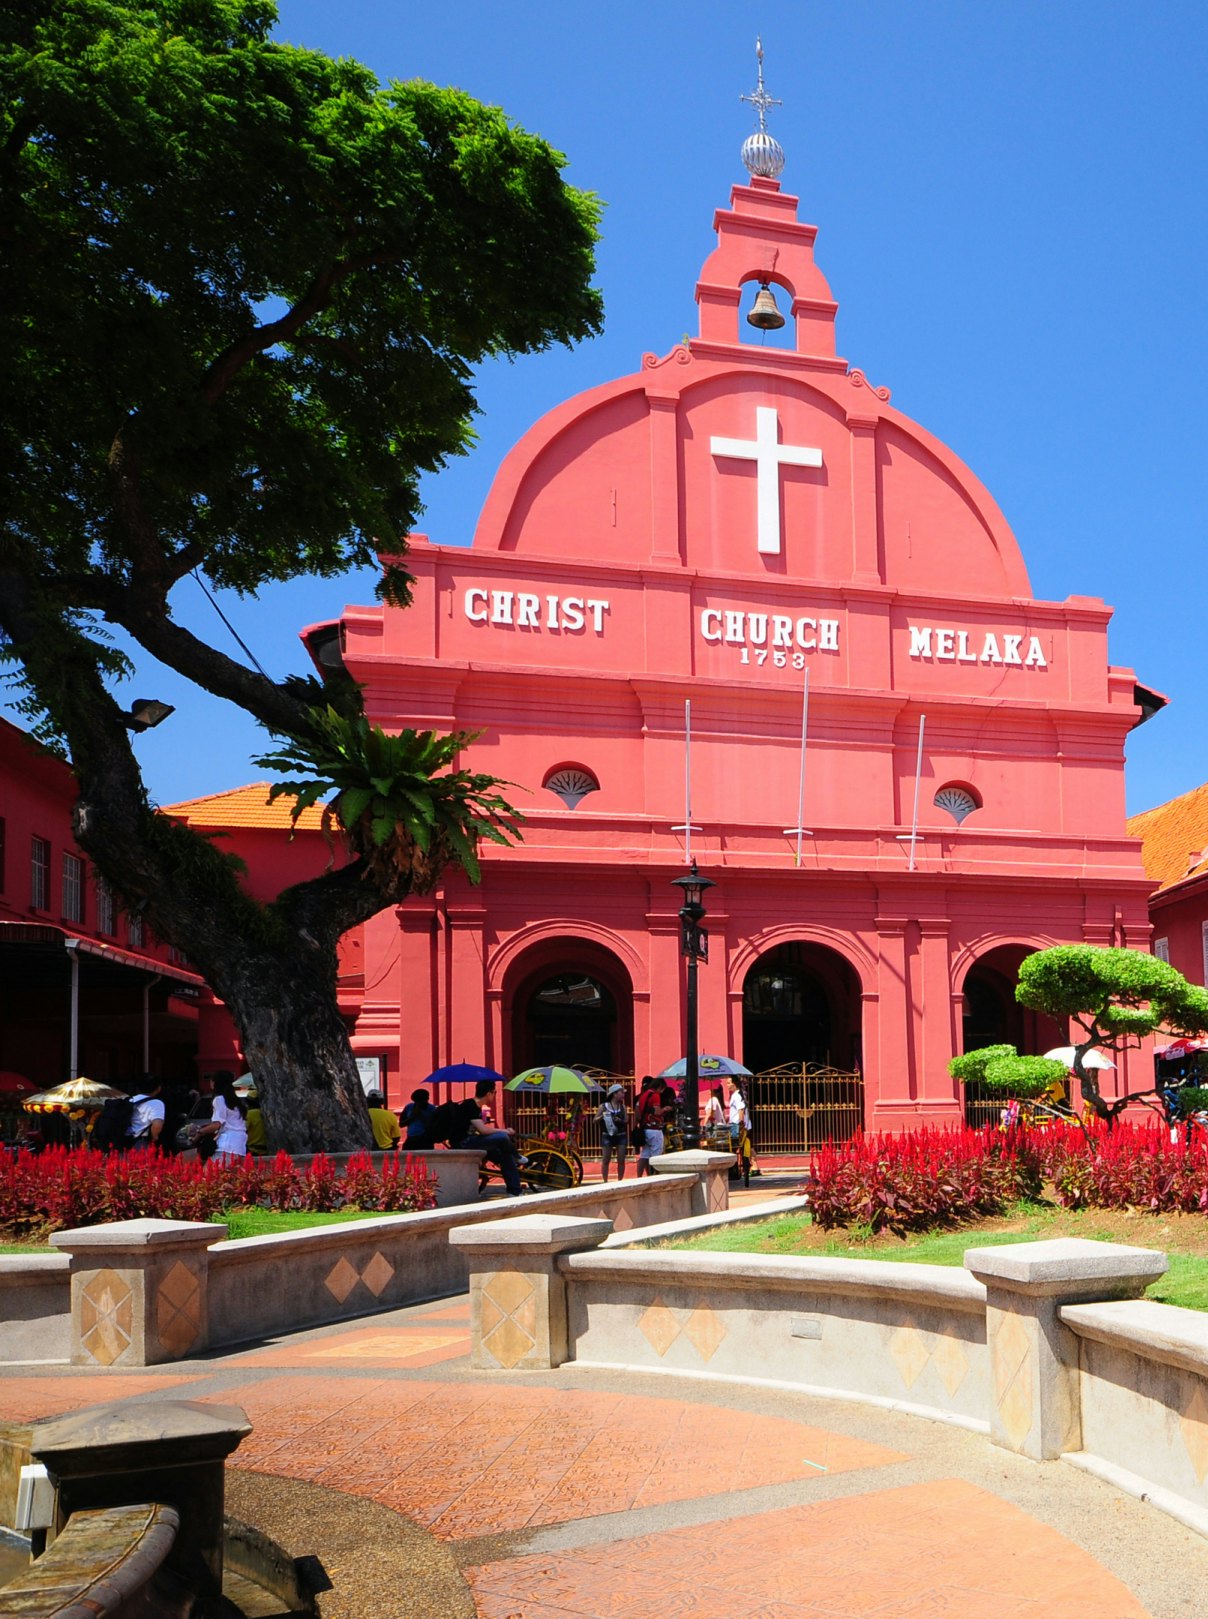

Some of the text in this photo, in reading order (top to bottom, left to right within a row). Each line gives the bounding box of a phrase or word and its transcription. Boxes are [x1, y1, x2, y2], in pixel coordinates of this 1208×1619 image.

[465, 588, 1047, 666] CHRIST CHURCH MELAKA
[740, 647, 805, 669] 1753
